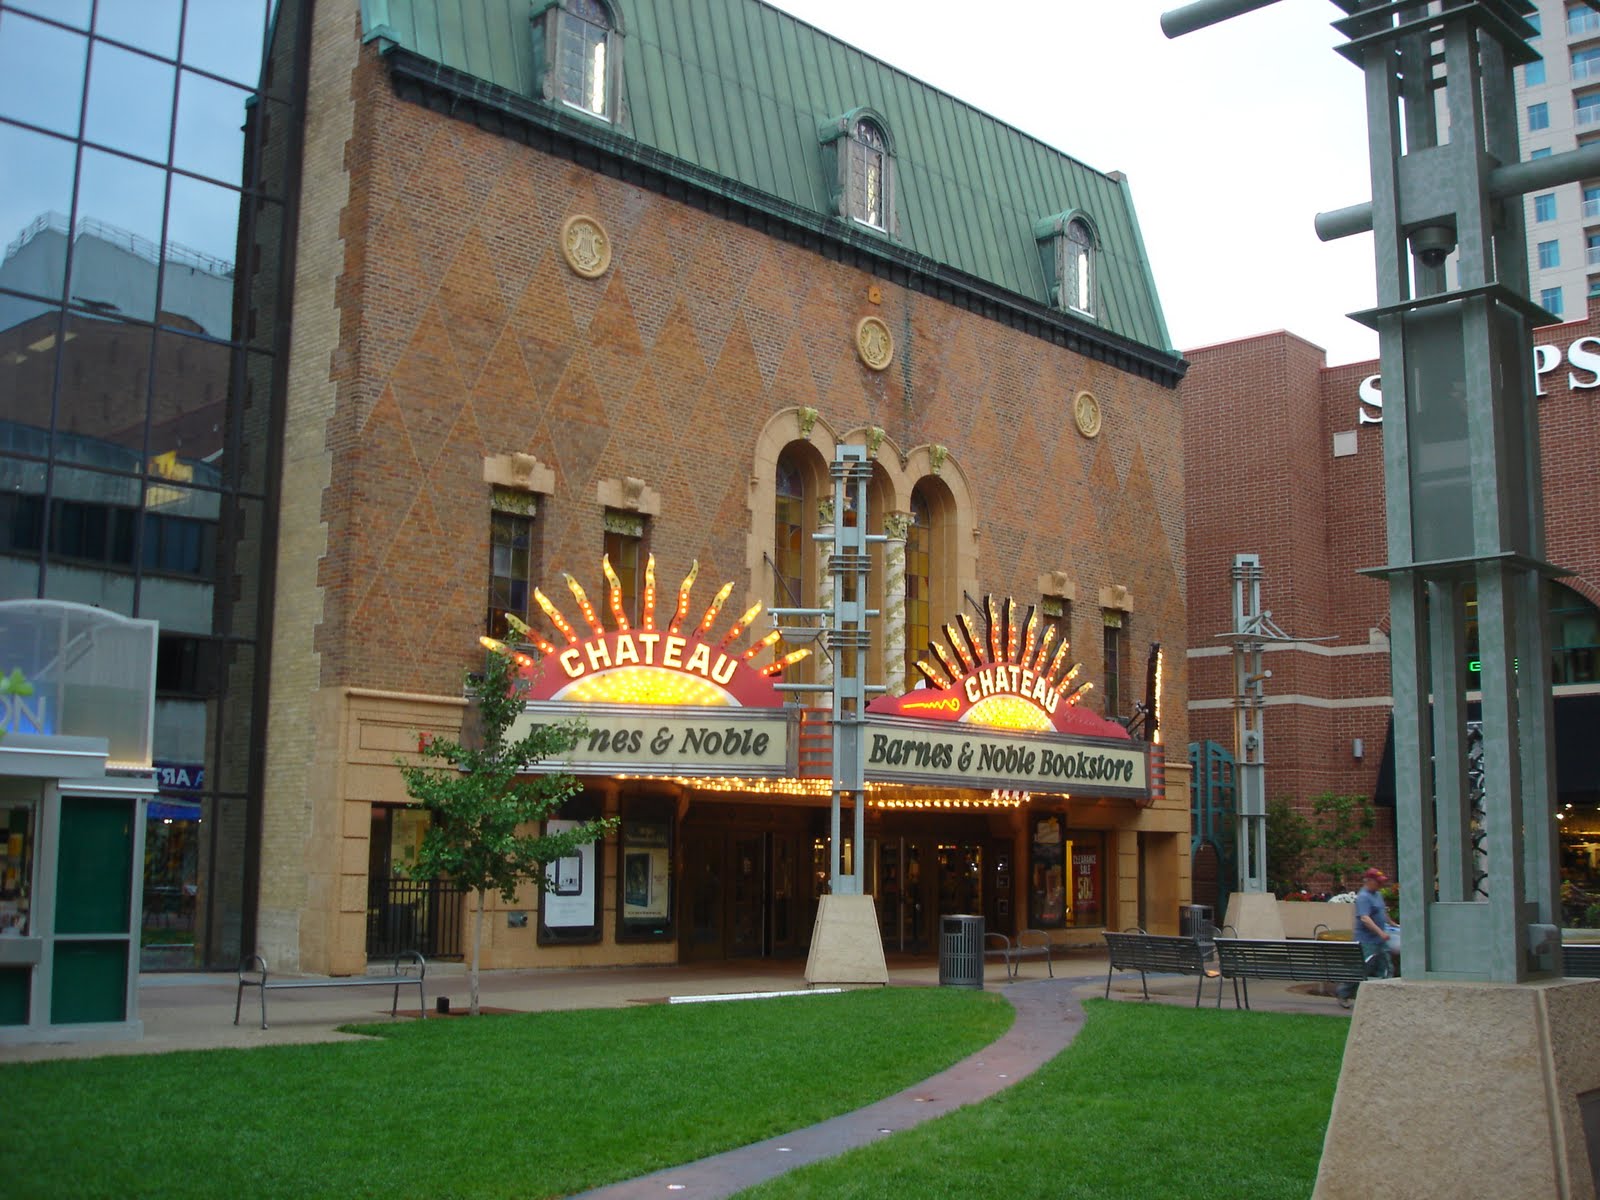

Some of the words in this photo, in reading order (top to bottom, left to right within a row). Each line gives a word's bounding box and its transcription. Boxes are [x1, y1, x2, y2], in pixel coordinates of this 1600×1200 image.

[559, 633, 738, 685] CHATEAU
[964, 665, 1060, 714] CHATEAU
[528, 723, 643, 754] rnes
[650, 726, 674, 756] &
[679, 727, 770, 756] Noble
[868, 734, 953, 769] Barnes
[957, 741, 974, 772] &
[976, 744, 1036, 775] Noble
[1038, 749, 1134, 782] Bookstore
[1080, 864, 1091, 875] SALE
